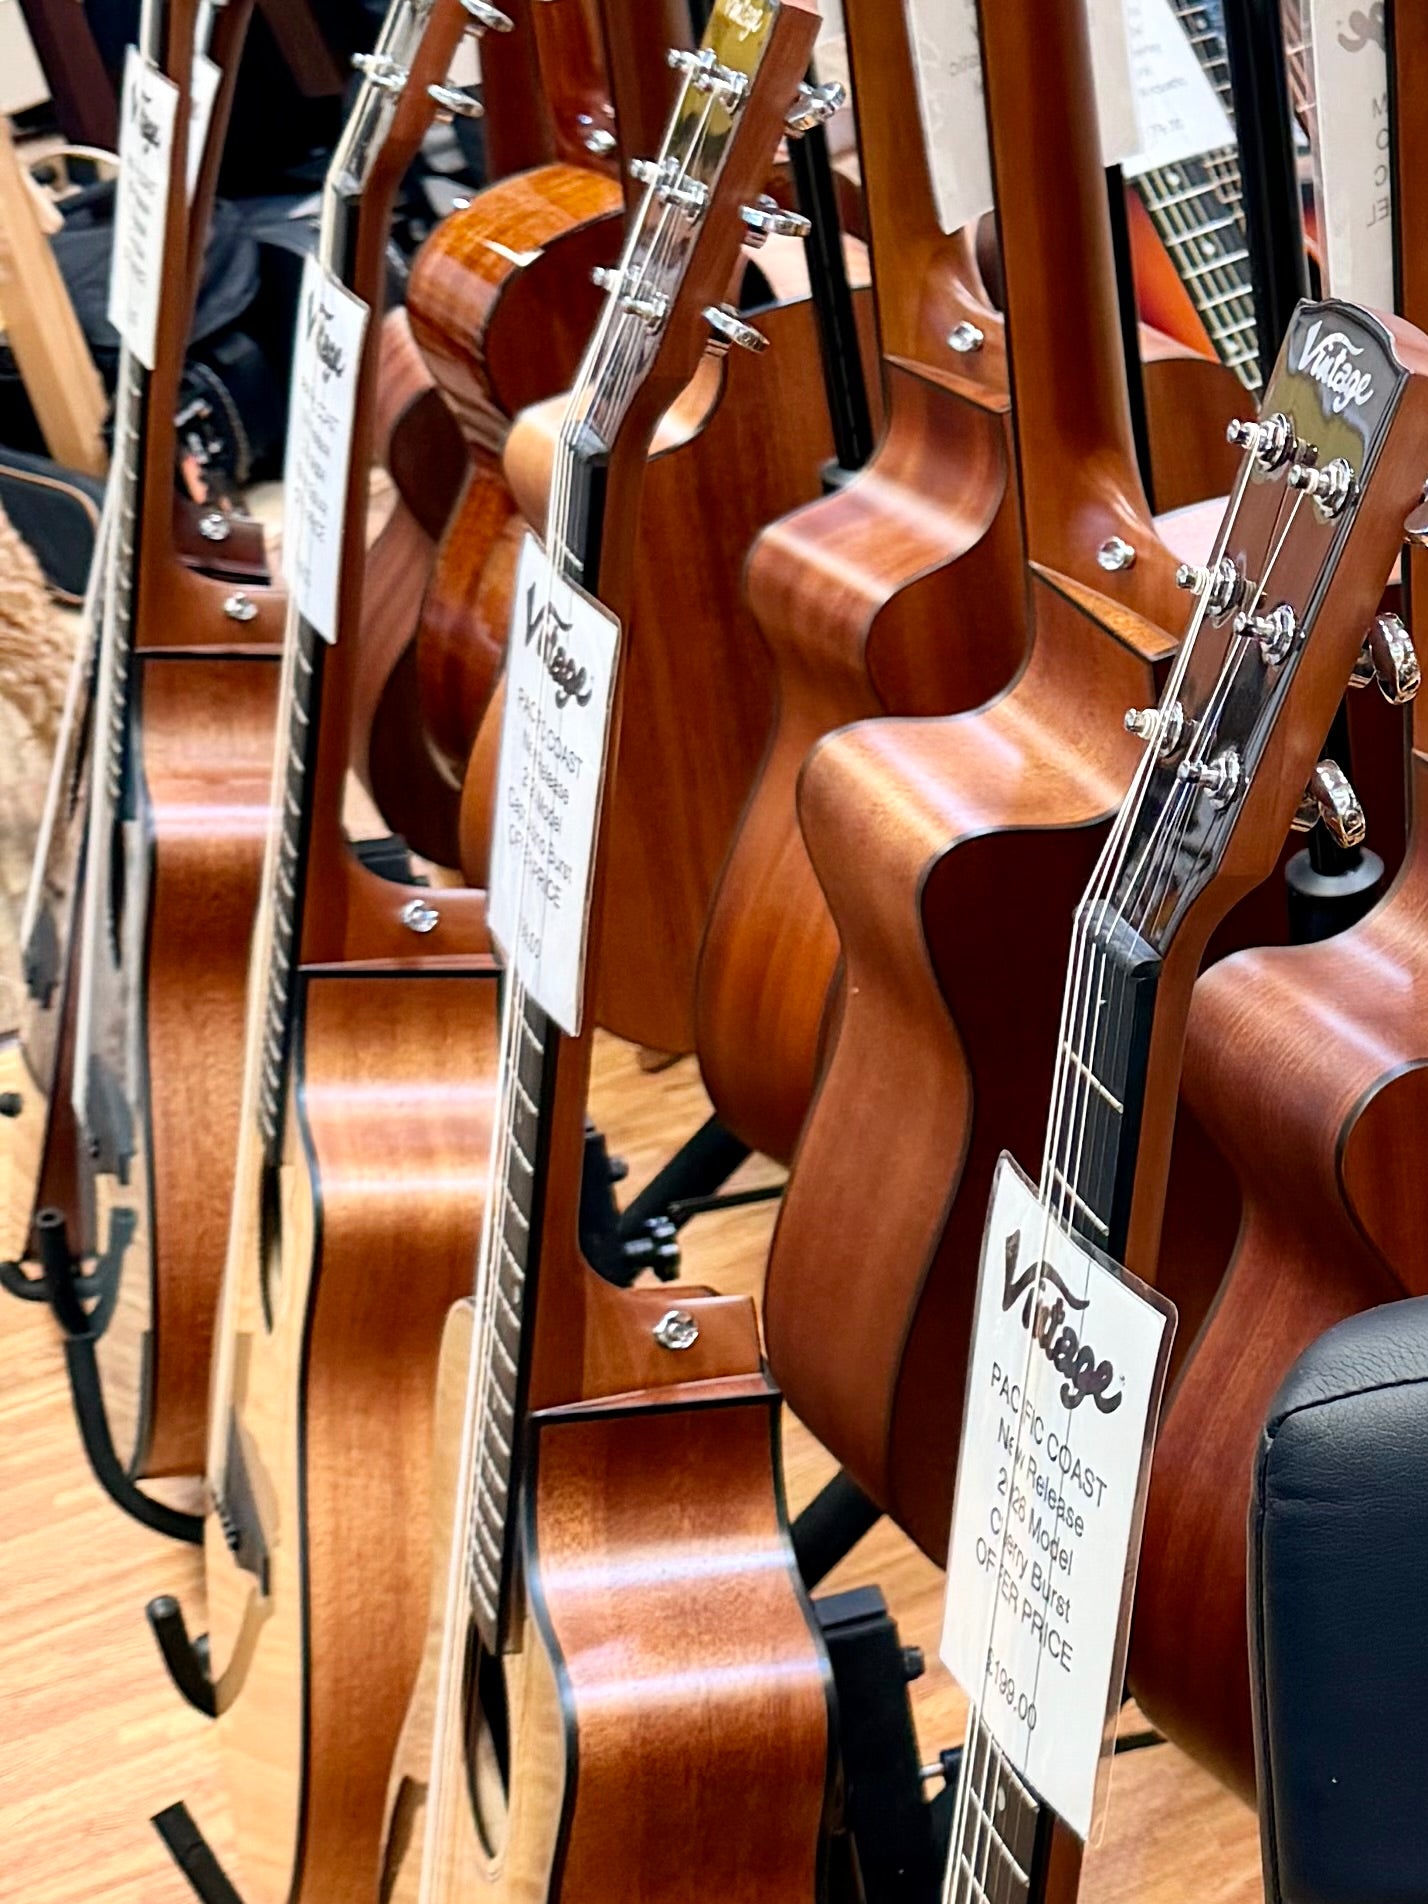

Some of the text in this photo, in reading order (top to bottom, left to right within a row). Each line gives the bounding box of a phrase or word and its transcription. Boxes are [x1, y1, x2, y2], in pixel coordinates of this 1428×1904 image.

[1297, 319, 1376, 413] Vintage
[1001, 1228, 1123, 1414] Vintage
[991, 1361, 1108, 1508] PACFIC COAST
[1026, 1455, 1085, 1538] Release
[1027, 1507, 1073, 1577] Model
[976, 1536, 1074, 1673] OFER PRICE
[990, 1506, 1071, 1624] Cerry Burst
